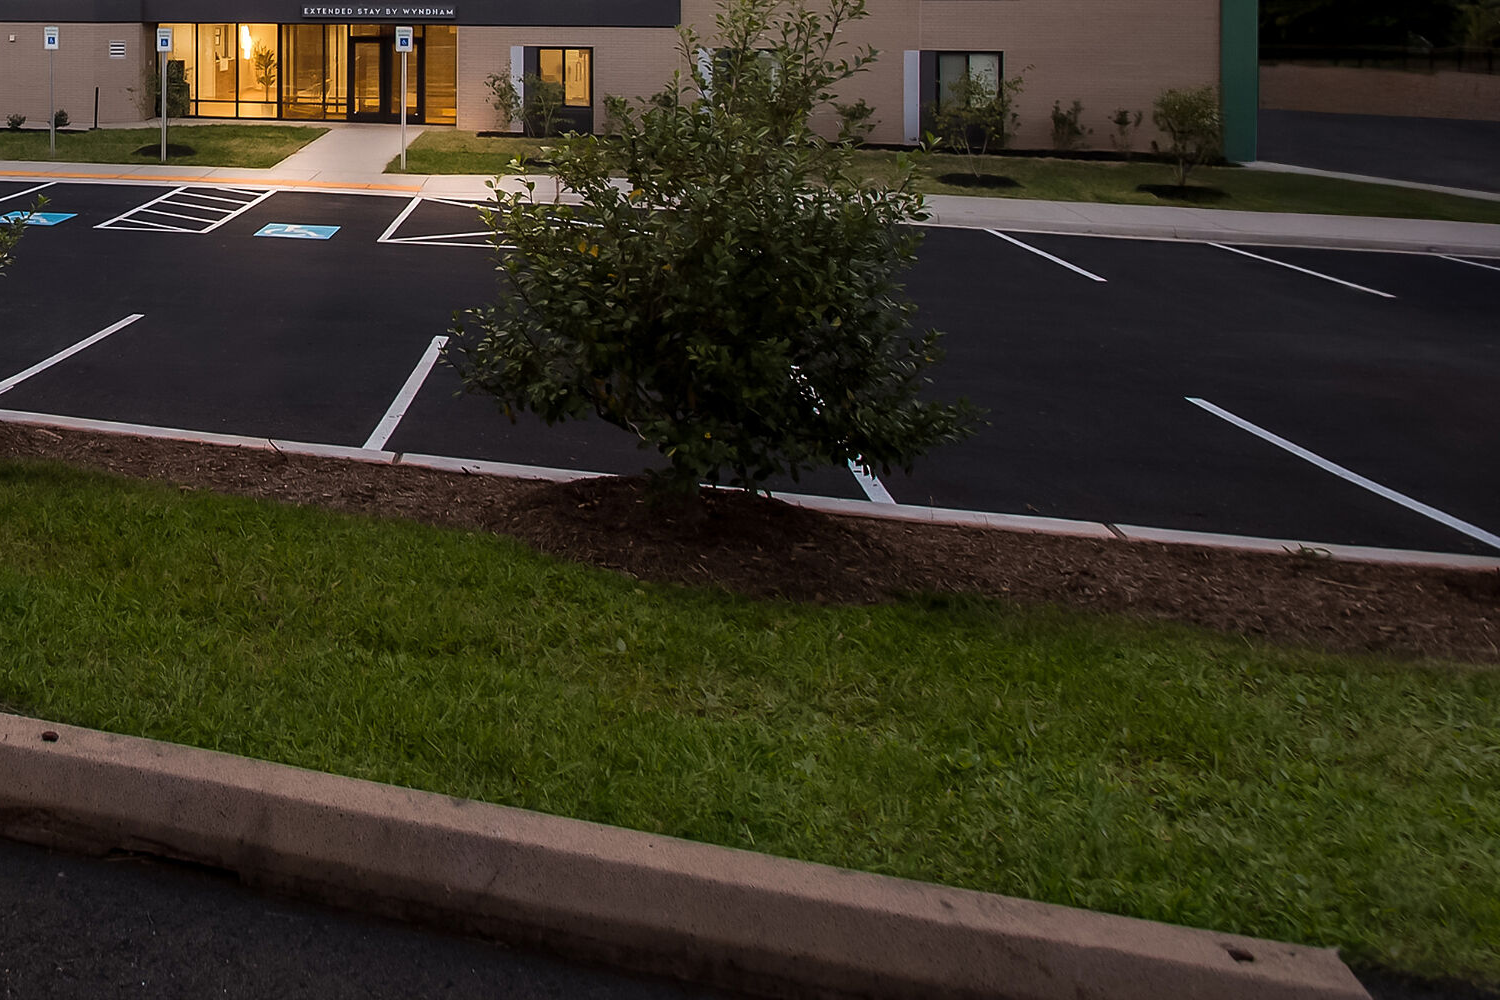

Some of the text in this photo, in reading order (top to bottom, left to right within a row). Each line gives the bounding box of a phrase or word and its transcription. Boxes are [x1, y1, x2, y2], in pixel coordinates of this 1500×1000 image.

[303, 7, 454, 16] EXTENDED STAY BY WYNDHAM
